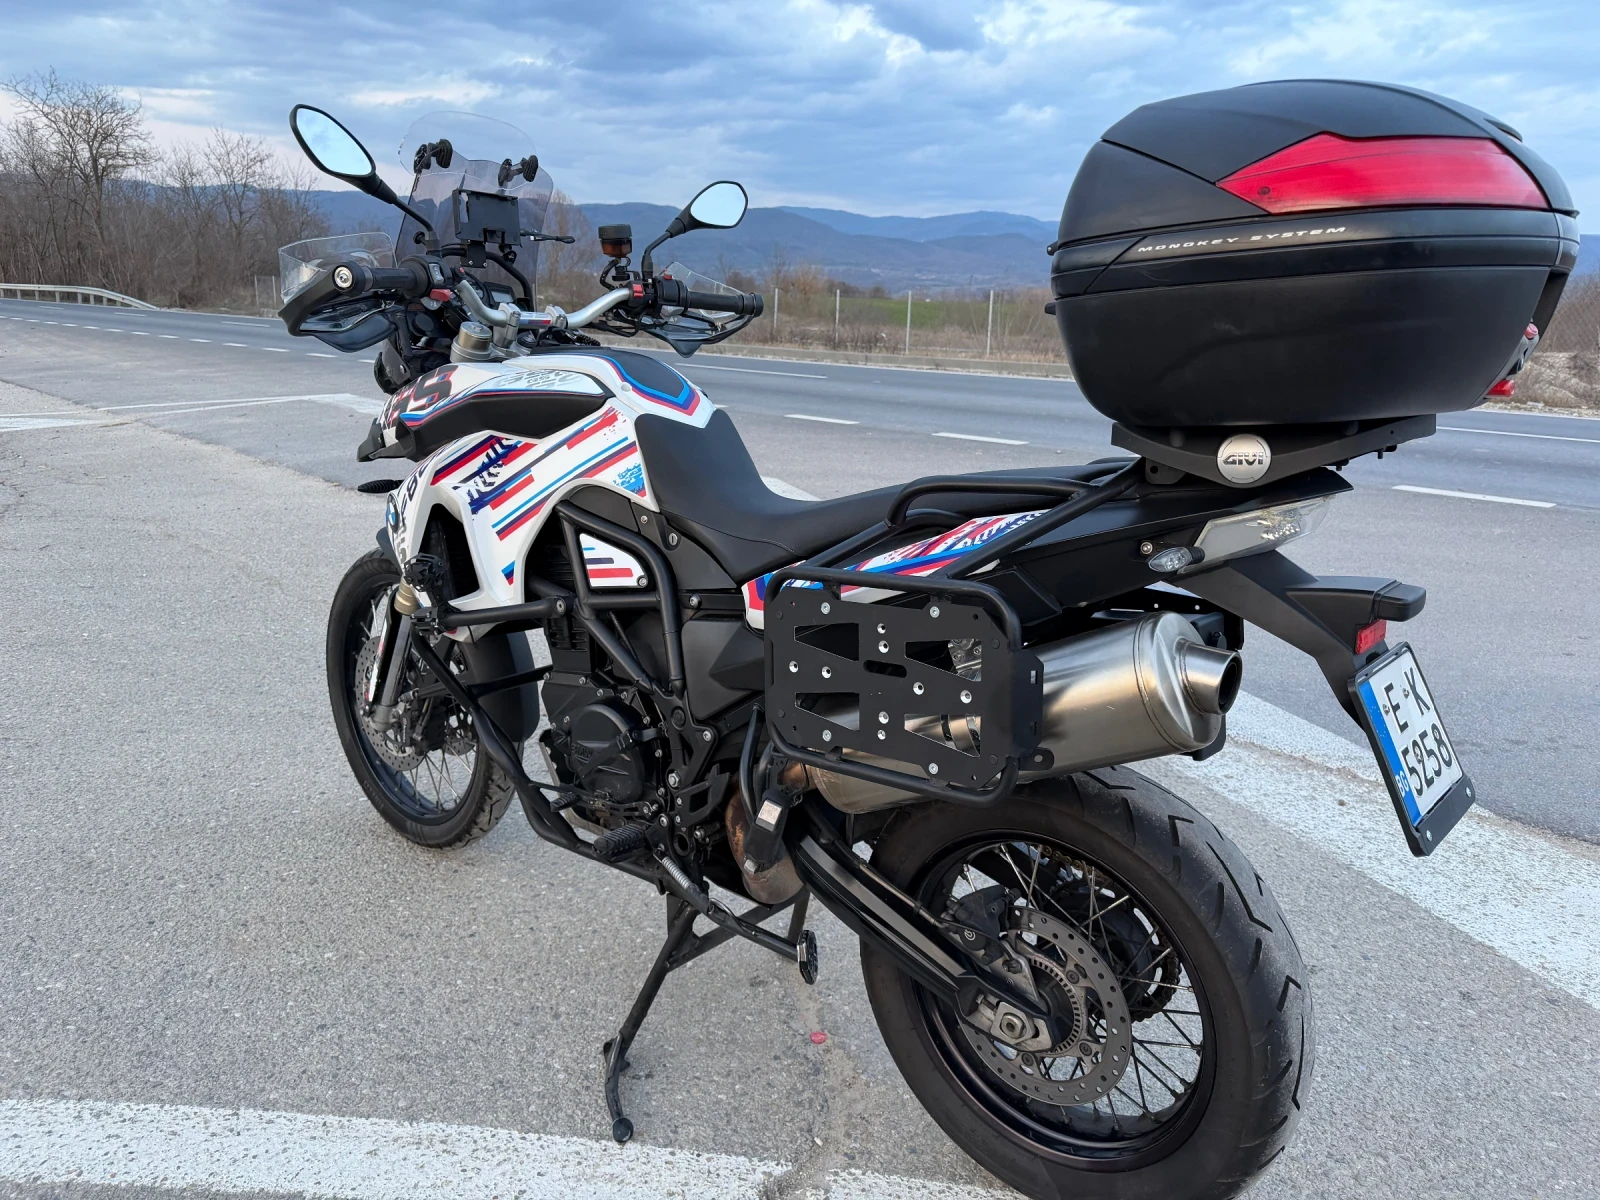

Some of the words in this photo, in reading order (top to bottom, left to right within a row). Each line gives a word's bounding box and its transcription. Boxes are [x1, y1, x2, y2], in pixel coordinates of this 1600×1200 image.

[1137, 237, 1239, 253] MONOKEY
[1249, 226, 1346, 242] SYSTEM
[1223, 452, 1264, 466] GIVI
[1383, 682, 1409, 734] E
[1403, 667, 1431, 716] K
[1401, 722, 1453, 797] 5258
[1395, 771, 1410, 797] BG
